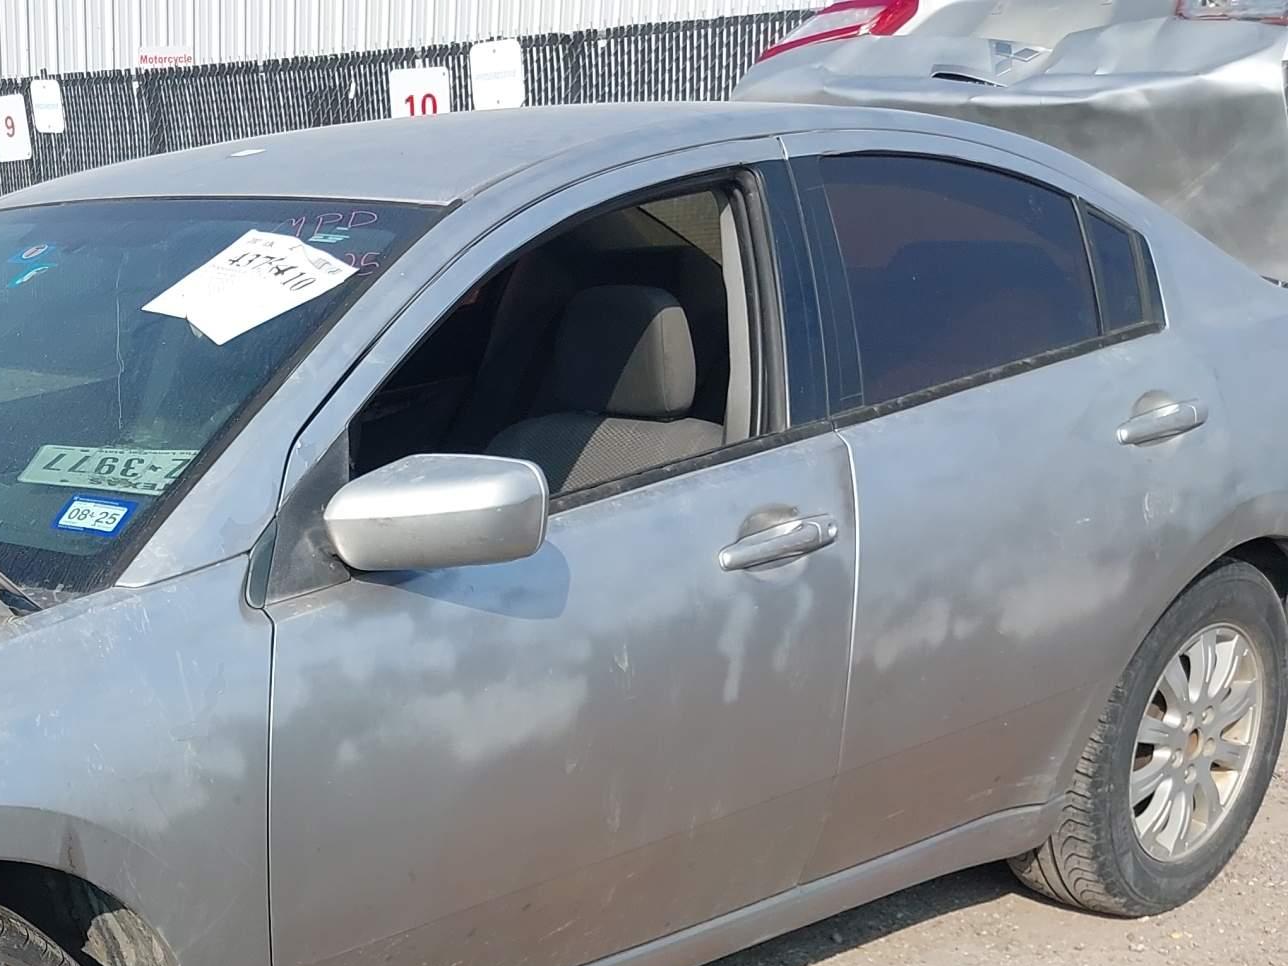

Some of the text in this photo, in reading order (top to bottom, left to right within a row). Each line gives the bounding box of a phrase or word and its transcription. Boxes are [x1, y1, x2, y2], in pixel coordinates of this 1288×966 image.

[139, 54, 193, 66] Motorcycle
[404, 93, 438, 117] 10
[4, 115, 16, 138] 9
[42, 453, 145, 478] 3977
[67, 508, 121, 525] 08 25
